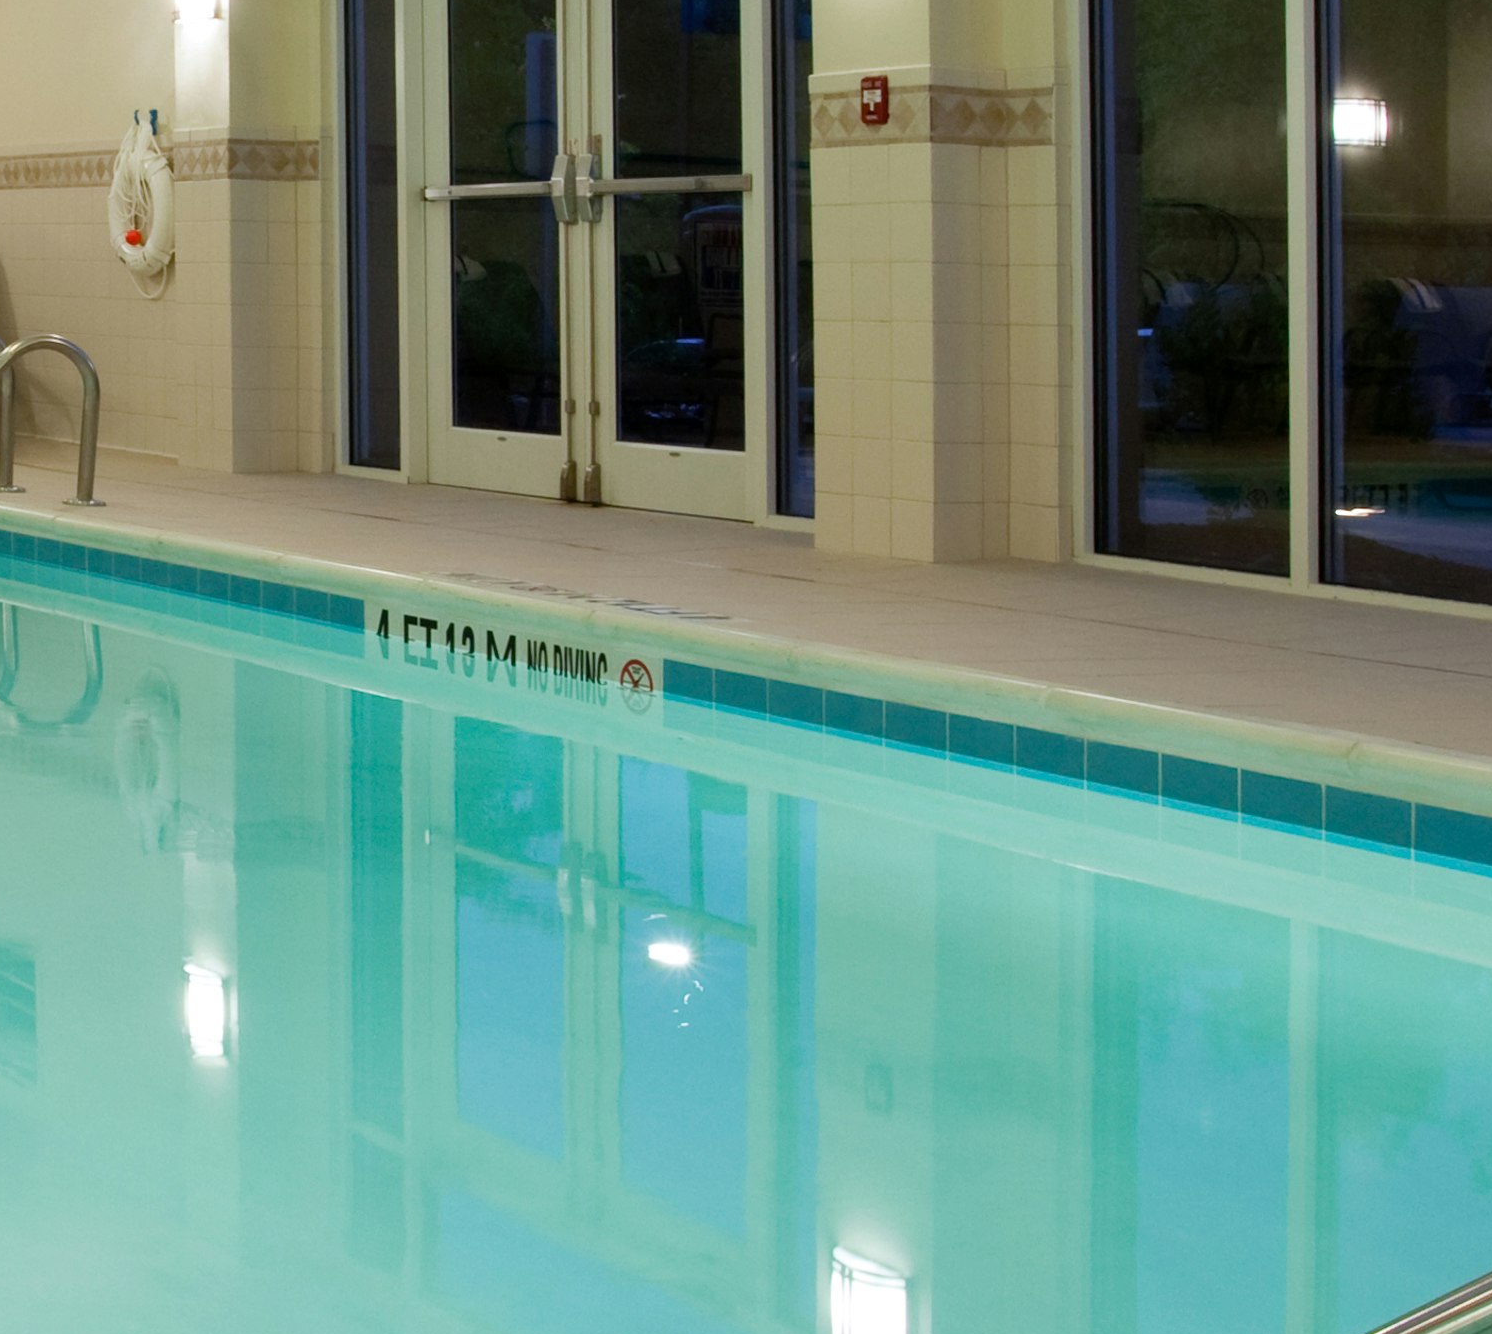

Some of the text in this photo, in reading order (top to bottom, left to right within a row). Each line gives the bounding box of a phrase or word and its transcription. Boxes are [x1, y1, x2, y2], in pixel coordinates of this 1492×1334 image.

[486, 629, 517, 667] M
[526, 638, 549, 673] NO
[553, 643, 608, 686] DIVING
